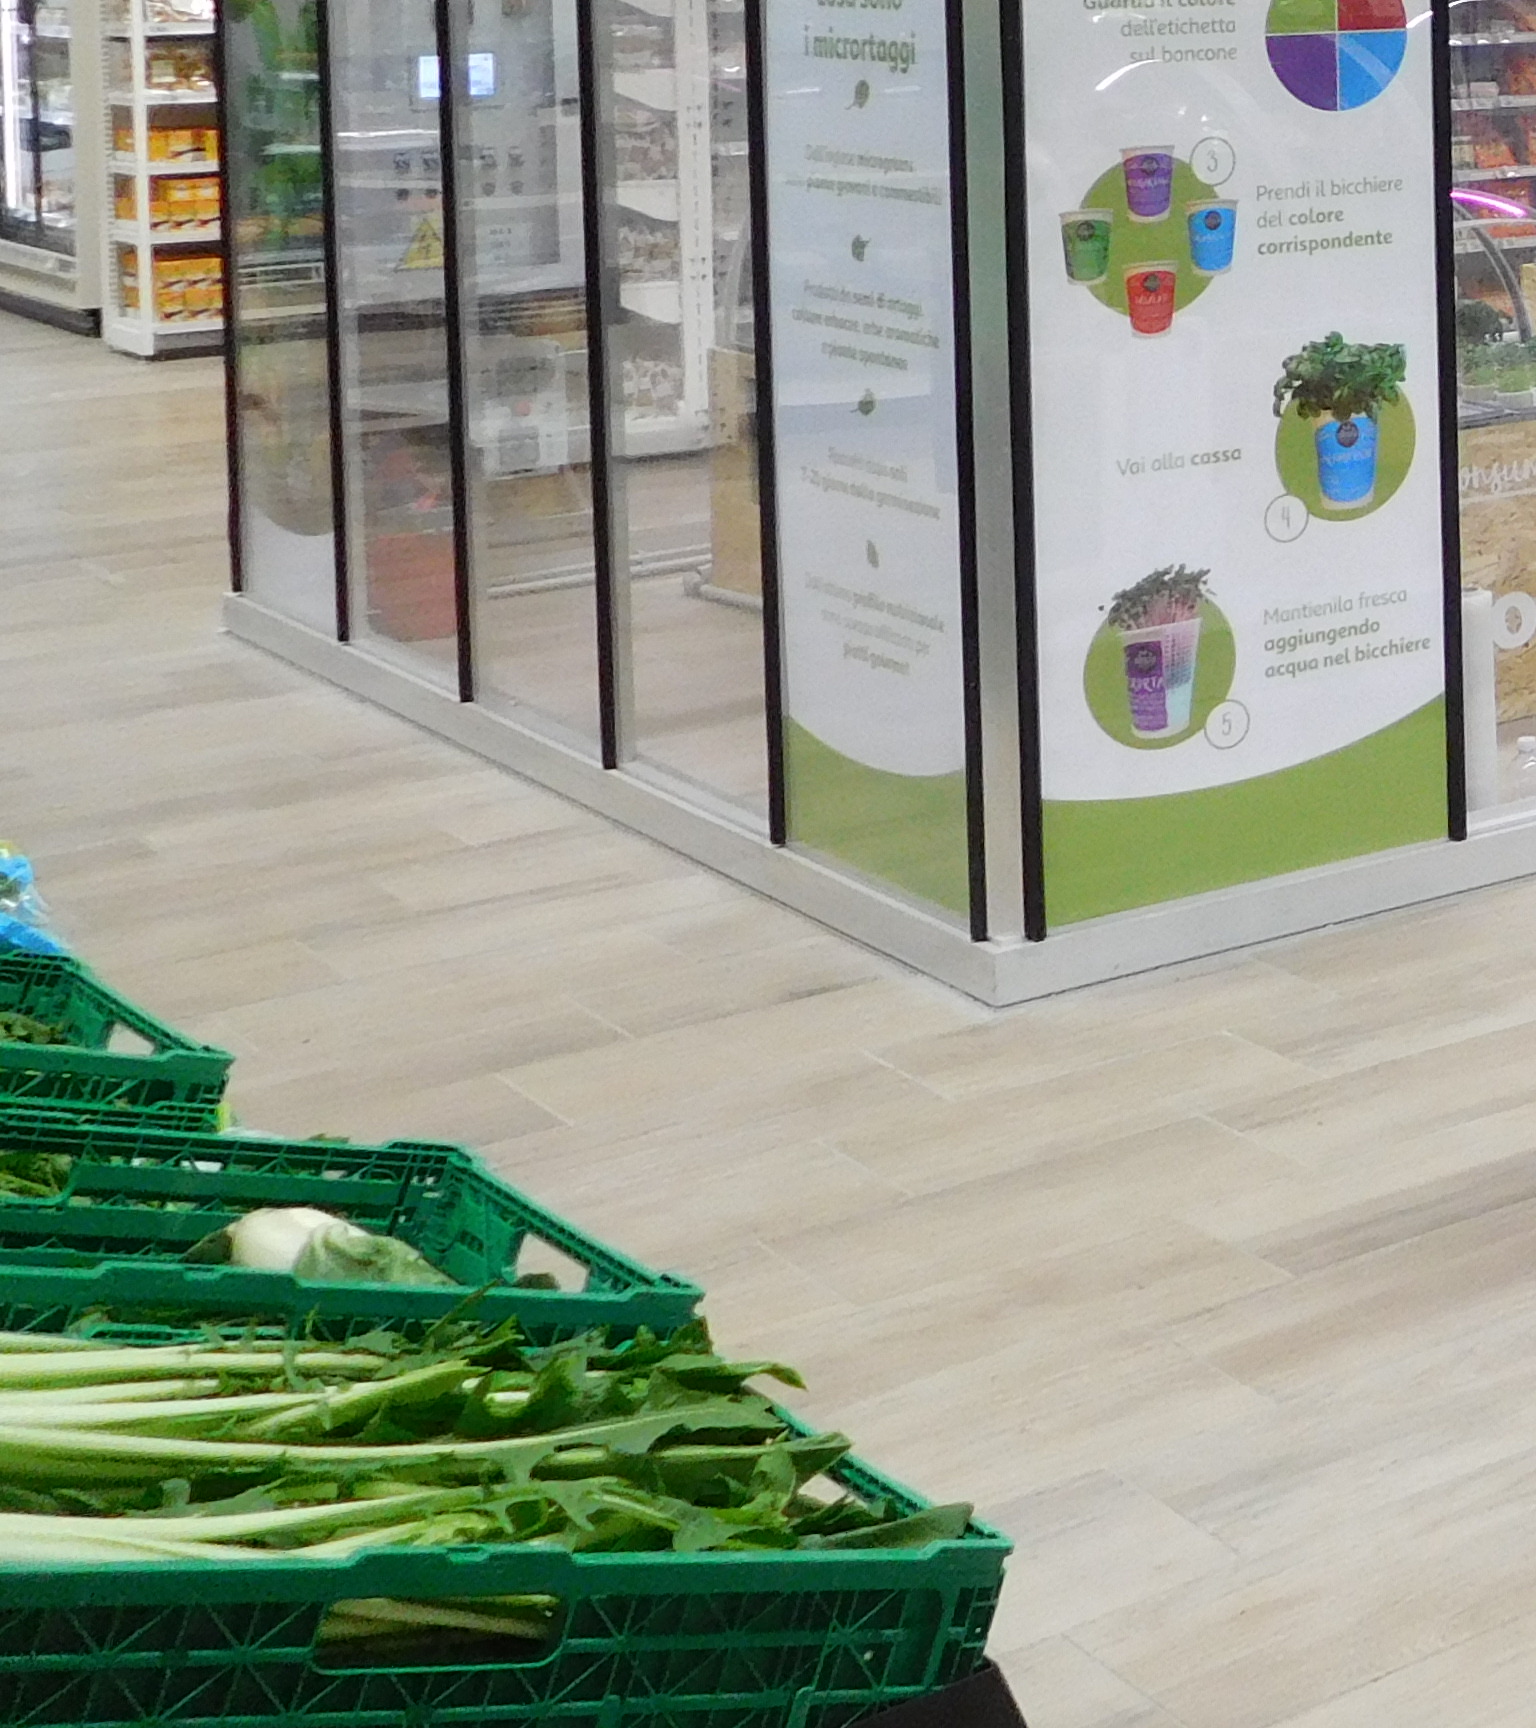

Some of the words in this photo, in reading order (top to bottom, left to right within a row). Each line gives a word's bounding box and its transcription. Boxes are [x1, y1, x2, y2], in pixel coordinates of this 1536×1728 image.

[1119, 17, 1236, 38] dell'etichetta
[1129, 45, 1155, 62] sul
[1206, 149, 1219, 173] 3
[1256, 183, 1310, 203] Prendi
[1316, 182, 1327, 199] il
[1331, 177, 1403, 196] bicchiere
[1257, 209, 1284, 229] del
[1288, 207, 1345, 227] colore
[1257, 229, 1394, 260] corrispondente
[1117, 457, 1148, 477] Vai
[1151, 452, 1186, 473] alla
[1190, 448, 1242, 468] cassa
[1280, 506, 1291, 529] 4
[1262, 596, 1355, 626] Mantienila
[1358, 587, 1408, 609] fresca
[1263, 618, 1381, 654] aggiungendo
[1264, 658, 1319, 682] acqua
[1323, 646, 1350, 668] nel
[1354, 636, 1431, 662] bicchiere
[1220, 711, 1233, 736] 5
